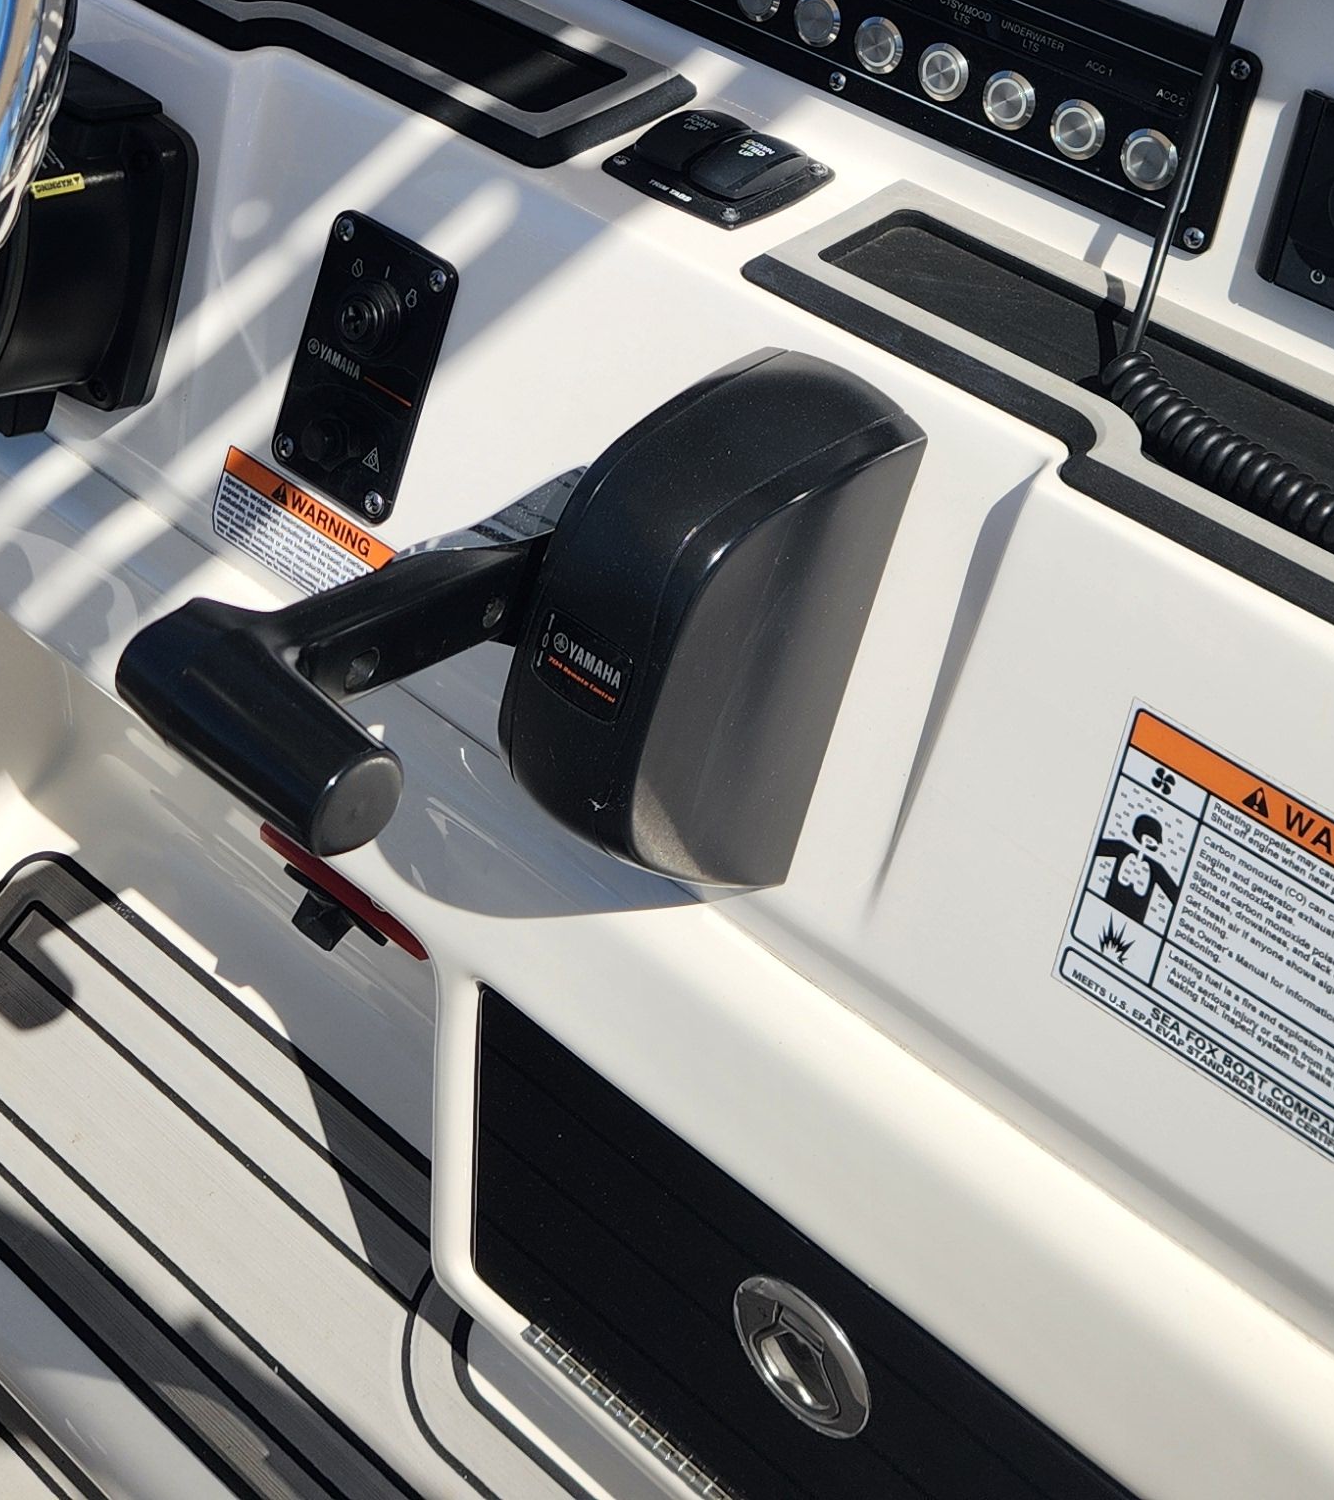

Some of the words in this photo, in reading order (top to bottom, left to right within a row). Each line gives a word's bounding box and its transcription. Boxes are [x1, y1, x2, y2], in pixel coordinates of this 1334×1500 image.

[953, 11, 970, 25] LTS
[1001, 19, 1065, 51] UNDERWATER
[1022, 38, 1040, 53] LTS
[738, 148, 754, 157] UP
[319, 345, 361, 382] YAMAHA
[291, 491, 371, 558] WARNING
[562, 665, 589, 687] Remote
[569, 640, 621, 689] YAMAHA
[1210, 811, 1232, 832] Shut
[1232, 825, 1247, 840] off
[1246, 834, 1280, 862] engine
[1280, 854, 1307, 876] when
[1307, 872, 1330, 891] near
[1212, 801, 1252, 833] Rotating
[1252, 825, 1296, 859] propeller
[1295, 853, 1317, 872] may
[1191, 870, 1218, 895] Signs
[1219, 887, 1230, 900] of
[1230, 894, 1263, 921] carbon
[1264, 915, 1311, 950] monoxide
[1195, 857, 1228, 884] carbon
[1228, 878, 1275, 913] monoxide
[1198, 848, 1231, 876] Engine
[1231, 868, 1250, 886] and
[1250, 880, 1297, 917] generator
[1202, 835, 1237, 862] Carbon
[1237, 856, 1284, 891] monoxide
[1283, 884, 1307, 907] (CO)
[1307, 900, 1326, 917] can
[1177, 917, 1195, 934] See
[1196, 928, 1234, 958] Owner's
[1234, 953, 1269, 980] Manual
[1269, 975, 1284, 990] for
[1184, 894, 1202, 911] Get
[1202, 905, 1226, 926] fresh
[1227, 920, 1240, 935] air
[1241, 929, 1249, 940] if
[1248, 936, 1284, 965] anyone
[1284, 956, 1317, 983] shows
[1291, 944, 1311, 962] and
[1311, 956, 1332, 975] lack
[1167, 950, 1203, 981] Leaking
[1204, 973, 1222, 991] fuel
[1223, 985, 1232, 997] is
[1233, 993, 1240, 1003] a
[1240, 996, 1258, 1013] fire
[1258, 1007, 1277, 1026] and
[1276, 1020, 1324, 1058] explosion
[1071, 968, 1106, 998] MEETS
[1131, 1008, 1153, 1029] EPA
[1154, 1023, 1184, 1050] EVAP
[1186, 1044, 1255, 1096] STANDARDS
[1256, 1091, 1293, 1122] USING
[1149, 1005, 1183, 1036] SEA
[1184, 1028, 1220, 1060] FOX
[1220, 1053, 1266, 1091] BOAT
